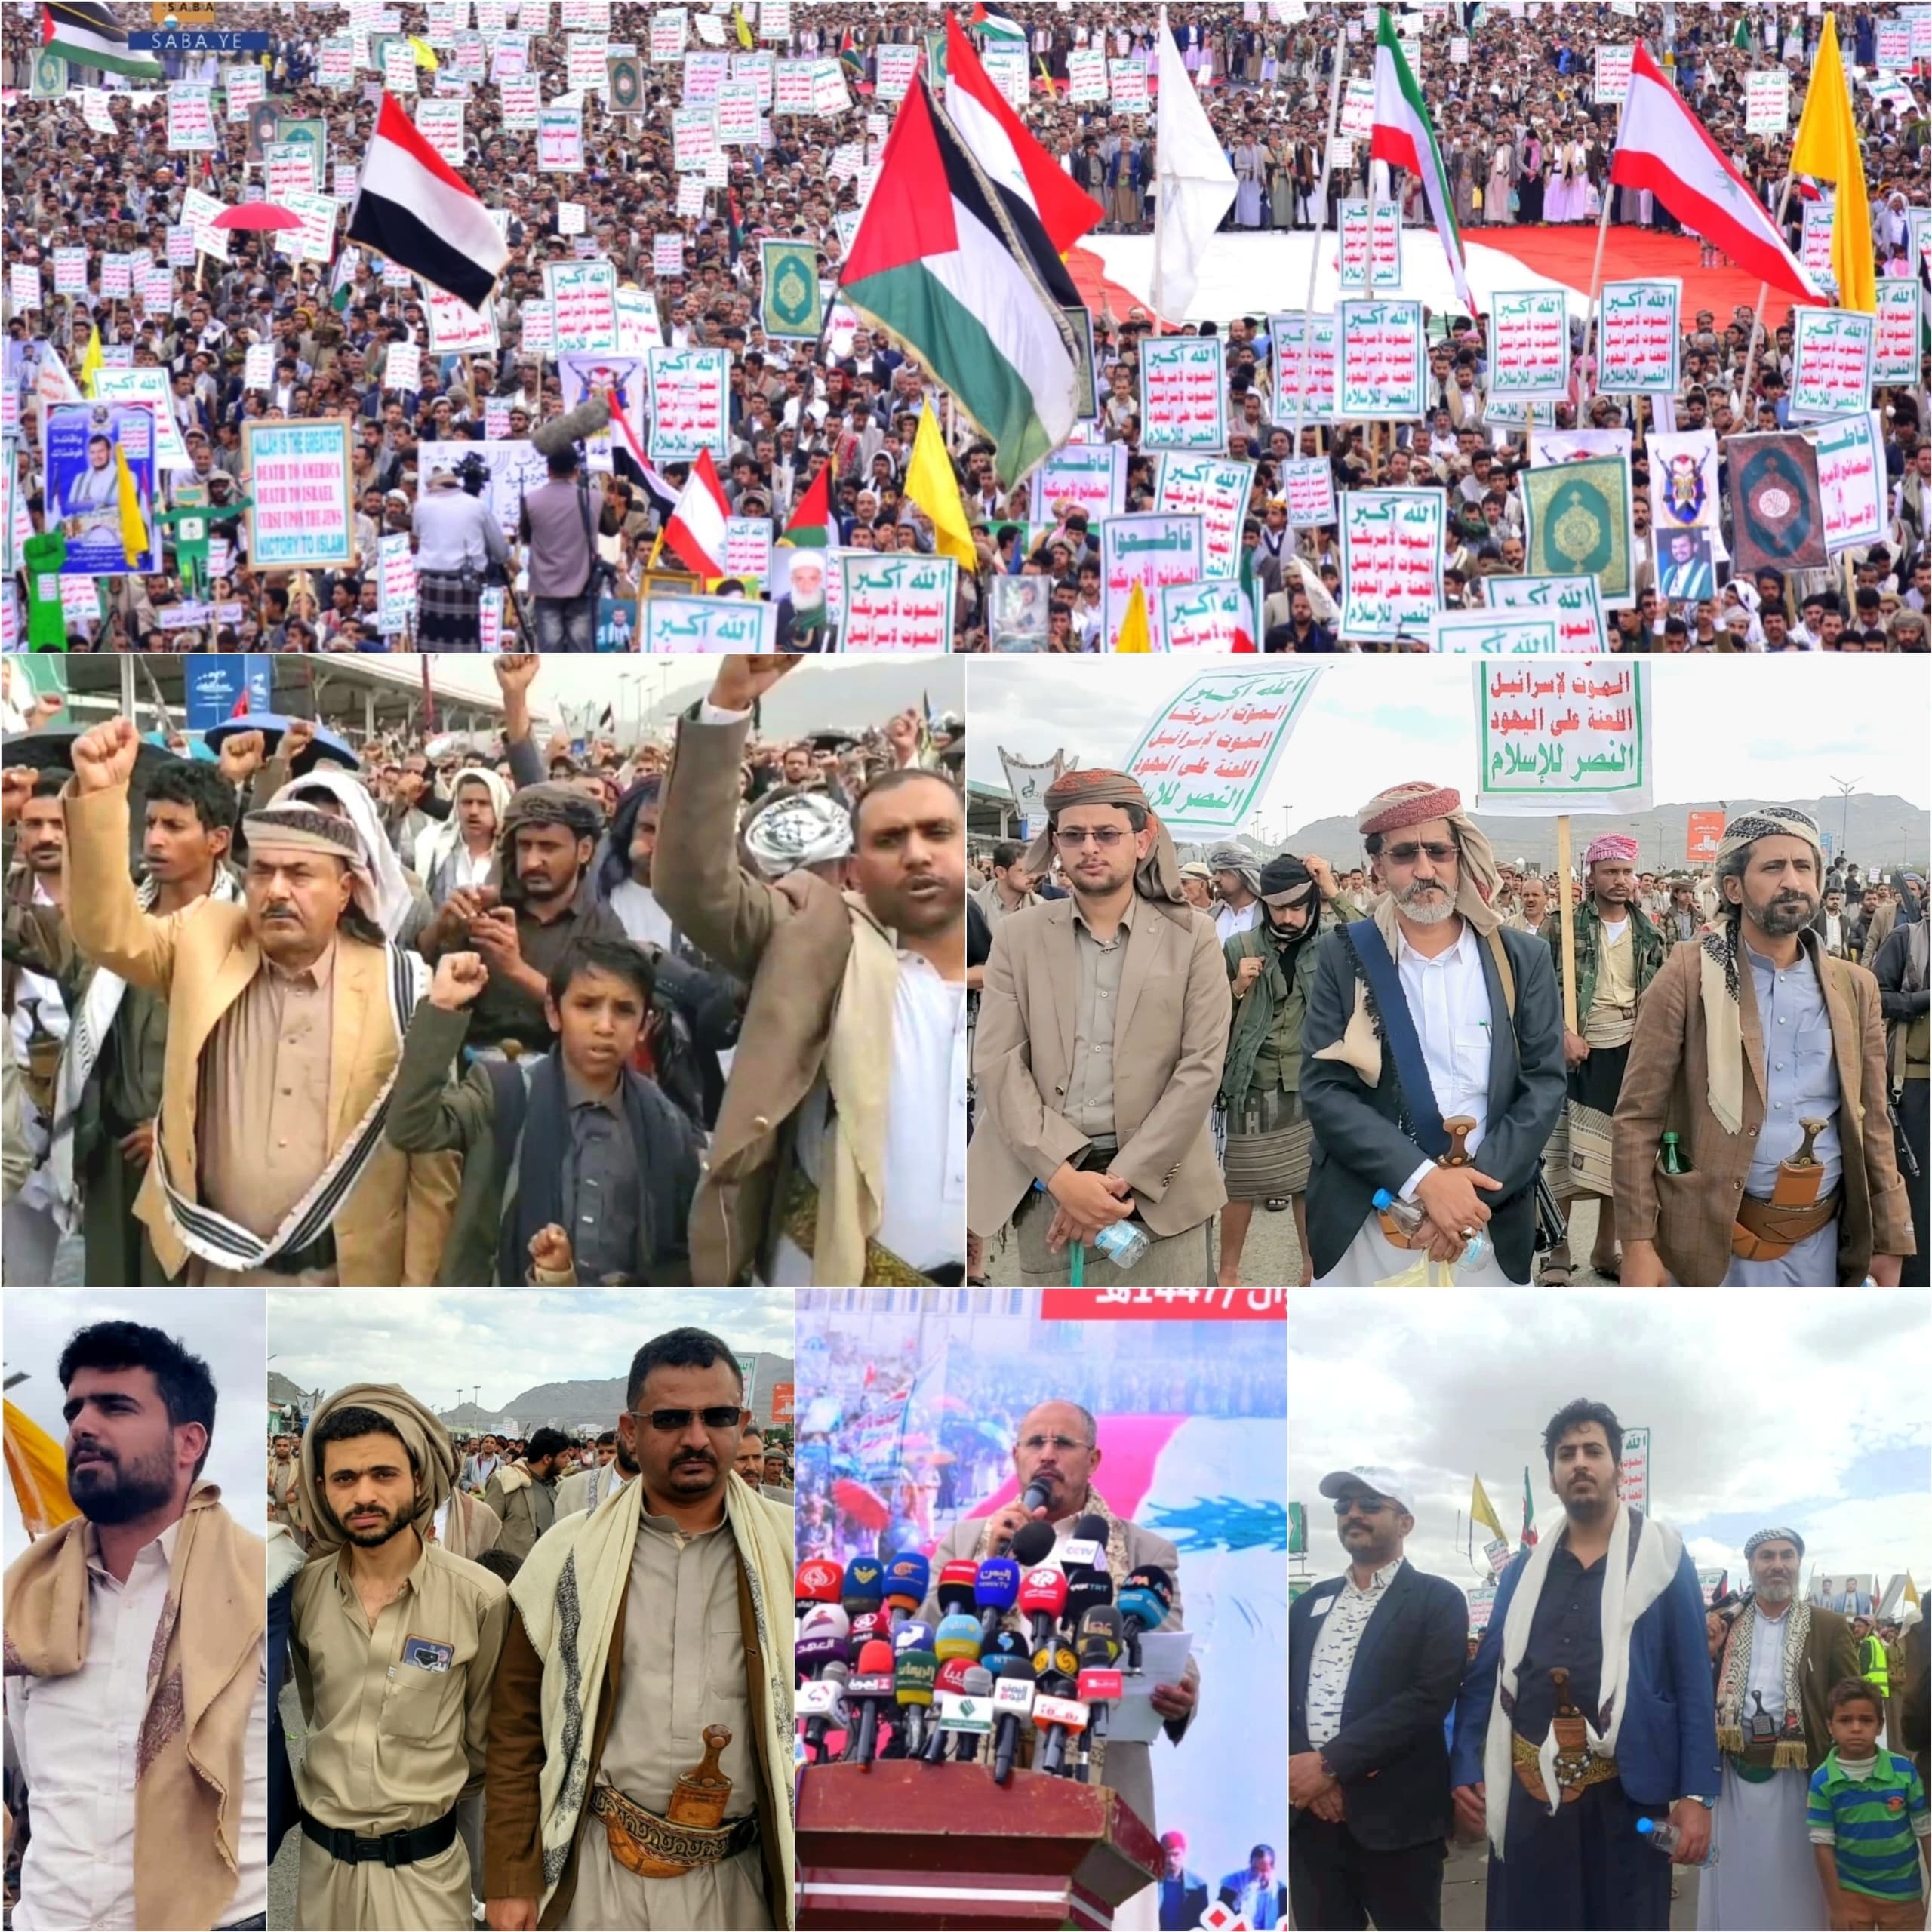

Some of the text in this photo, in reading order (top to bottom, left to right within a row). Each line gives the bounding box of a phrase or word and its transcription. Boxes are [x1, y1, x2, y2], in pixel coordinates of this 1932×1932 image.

[1497, 295, 1561, 318] الله أكبر
[1605, 287, 1673, 312] الله أكبر
[1346, 303, 1415, 330] الله أكبر
[1533, 320, 1561, 332] الموت
[1643, 315, 1671, 328] الموت
[1804, 317, 1867, 339] الله أكبر
[1386, 332, 1415, 346] الموت
[1534, 337, 1561, 349] الموت
[1643, 334, 1671, 346] الموت
[1147, 343, 1217, 368] الله أكبر
[1386, 351, 1415, 366] الموت
[1605, 350, 1670, 366] اللعنة على اليهود
[1838, 344, 1866, 356] الموت
[656, 350, 721, 375] الله أكبر
[1498, 355, 1561, 368] اللعنة على اليهود
[1837, 361, 1865, 373] الموت
[1186, 369, 1216, 385] الموت
[1346, 370, 1415, 385] اللعنة على اليهود
[1533, 368, 1561, 386] النصر
[1640, 365, 1669, 386] النصر
[1799, 375, 1864, 388] اللعنة على اليهود
[1187, 389, 1217, 405] الموت
[1385, 386, 1415, 408] النصر
[1833, 392, 1863, 410] النصر
[1149, 408, 1217, 423] اللعنة على اليهود
[1187, 424, 1217, 446] النصر
[257, 462, 341, 481] DEATH TO AMERICA
[1215, 468, 1245, 488] الله
[257, 485, 334, 504] DEATH TO ISRAEL
[306, 510, 321, 527] THE
[323, 509, 343, 526] JEWS
[1349, 497, 1437, 527] الله أكبر
[260, 534, 345, 555] VICTORY TO ISLAM
[1112, 521, 1192, 560] قاطعوا
[1398, 533, 1435, 550] الموت
[1398, 557, 1435, 575] الموت
[851, 561, 945, 595] الله أكبر
[1351, 579, 1435, 599] اللعنة على اليهود
[1558, 584, 1592, 608] الله
[903, 601, 943, 621] الموت
[1169, 584, 1220, 624] أكبر
[655, 607, 755, 643] الله أكبر
[901, 627, 943, 648] الموت
[1183, 677, 1306, 705] الله أكبر
[1491, 670, 1630, 700] الموت لإسرائيل
[1232, 705, 1287, 724] الموت
[1491, 706, 1633, 737] اللعنة على اليهود
[1216, 731, 1273, 752] الموت
[1131, 755, 1260, 778] اللعنة على اليهود
[1491, 740, 1634, 785] النصر للإسلام
[1174, 785, 1245, 814] النصر
[1626, 1434, 1646, 1450] الله
